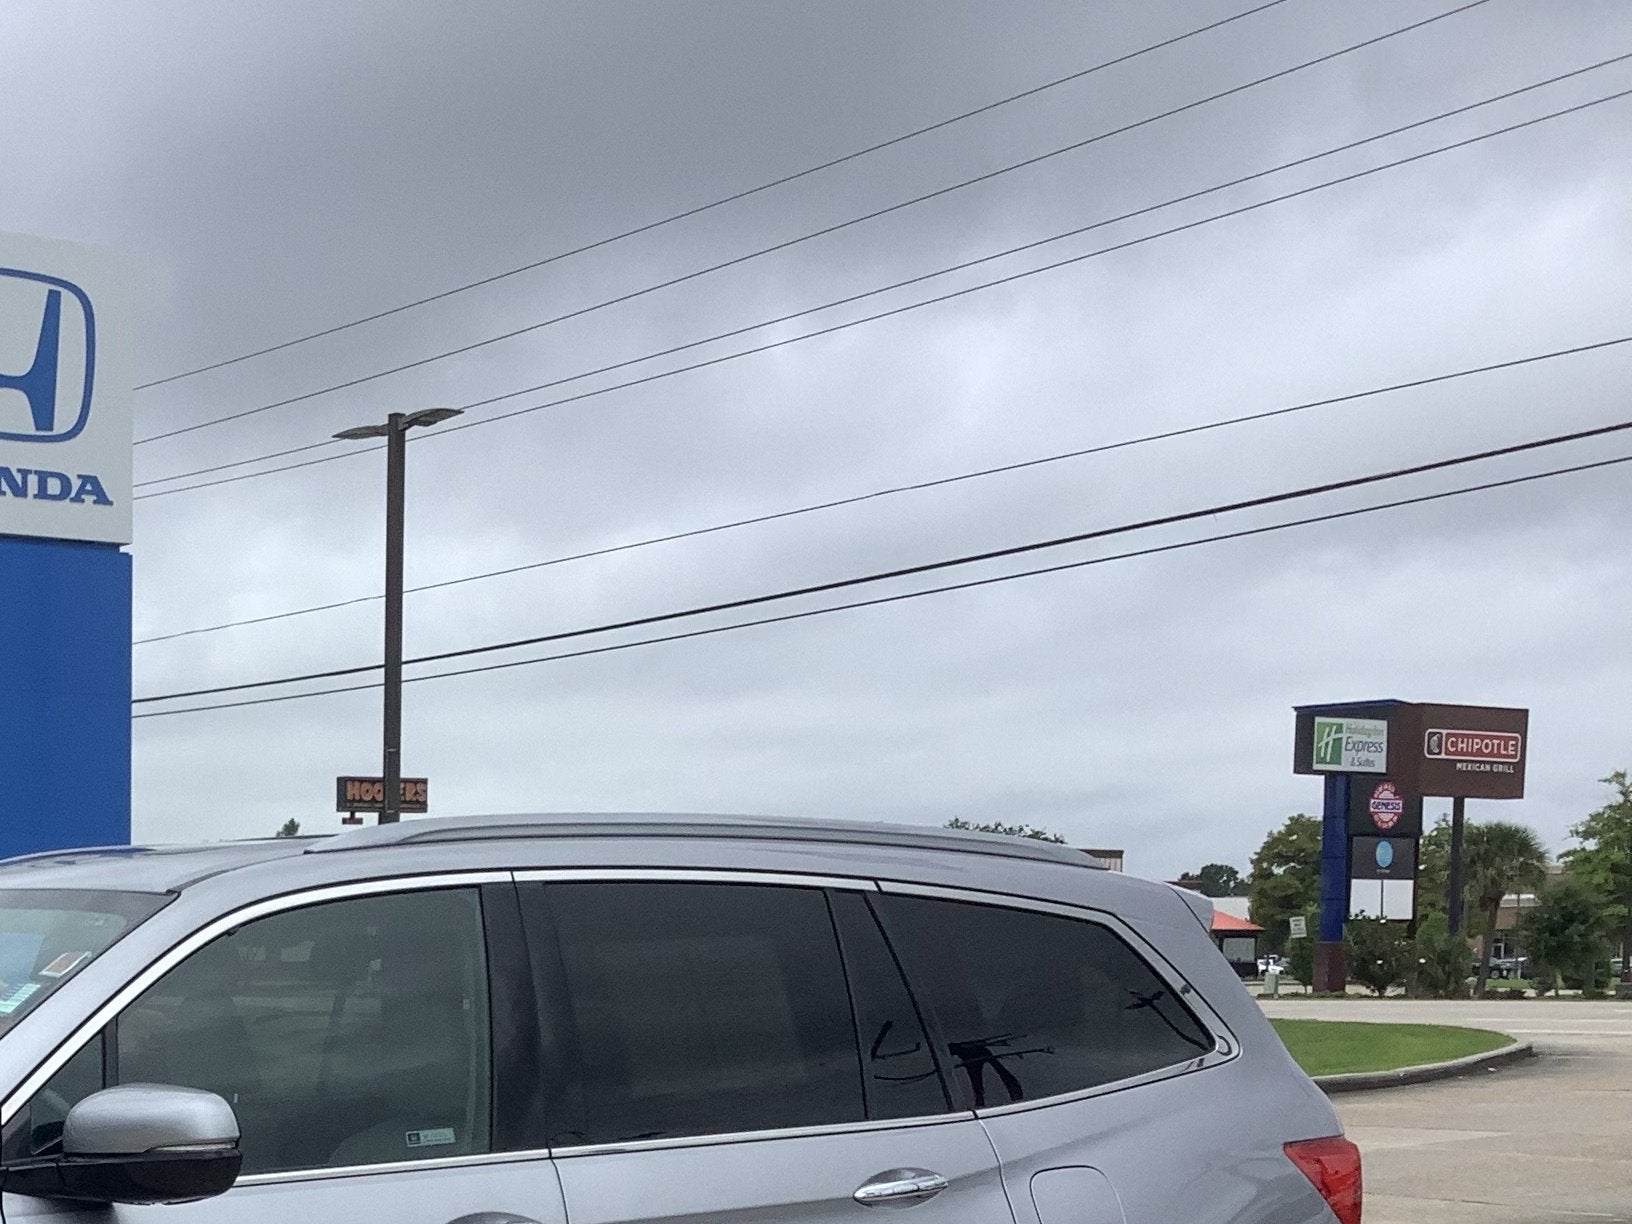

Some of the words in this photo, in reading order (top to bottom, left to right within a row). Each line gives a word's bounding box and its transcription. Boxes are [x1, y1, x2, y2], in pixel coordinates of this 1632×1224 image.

[1344, 735, 1385, 757] Express
[1447, 737, 1516, 755] CHIPOTLE
[1456, 762, 1491, 772] MEXICAN
[1492, 764, 1514, 773] GRILL
[346, 780, 426, 801] HOOERS
[1371, 800, 1401, 811] GENESIS
